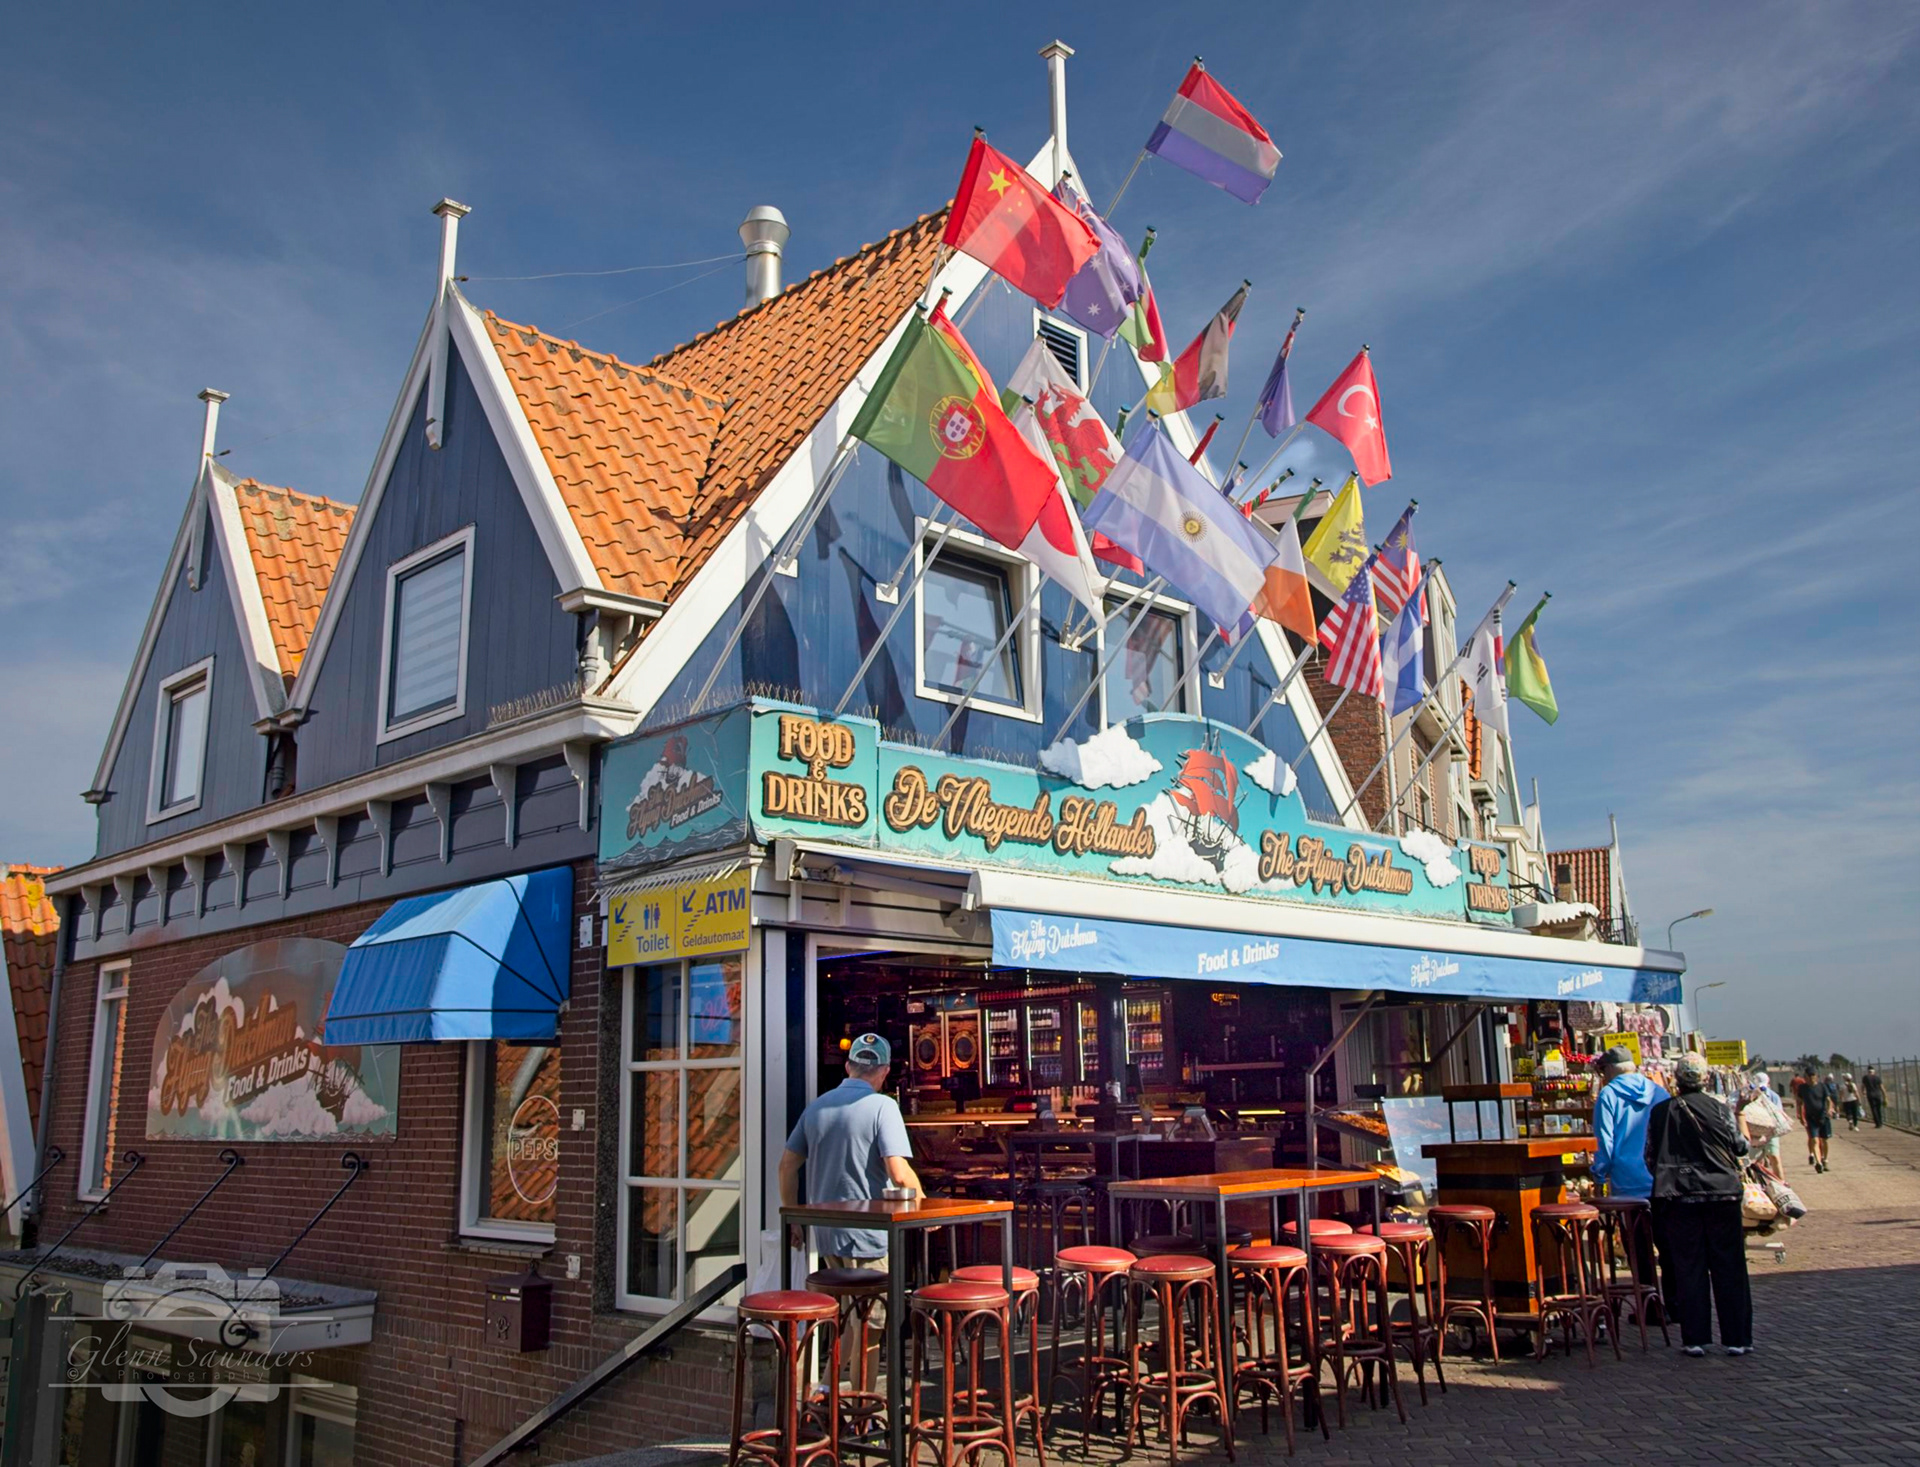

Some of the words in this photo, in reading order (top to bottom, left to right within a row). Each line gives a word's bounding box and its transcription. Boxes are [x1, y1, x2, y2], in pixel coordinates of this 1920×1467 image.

[781, 715, 853, 764] FOOD
[812, 760, 826, 781] &
[671, 809, 690, 826] Food
[690, 805, 696, 816] &
[697, 793, 721, 812] Drinks
[765, 772, 867, 823] DRINKS
[887, 769, 938, 827] De
[941, 777, 1052, 847] Vliegende
[1056, 799, 1155, 855] Hollander
[1262, 832, 1293, 876] The
[1296, 837, 1344, 893] Flying
[1347, 845, 1413, 893] Dutchman
[1470, 845, 1500, 874] FOOD
[704, 887, 746, 915] ATM
[1469, 883, 1509, 911] DRINKS
[636, 933, 671, 954] Toilet
[682, 929, 745, 948] Geldautomaat
[1011, 930, 1046, 961] Flying
[1046, 922, 1098, 954] Dutchman
[1030, 919, 1046, 939] The
[1198, 951, 1228, 974] Food
[1231, 949, 1239, 966] &
[1242, 940, 1280, 965] Drinks
[1558, 976, 1575, 995] Food
[1581, 969, 1603, 987] Drinks
[194, 1000, 218, 1053] The
[161, 1032, 211, 1113] Flying
[226, 1066, 255, 1103] Food
[256, 1065, 265, 1089] &
[267, 1046, 309, 1084] Drinks
